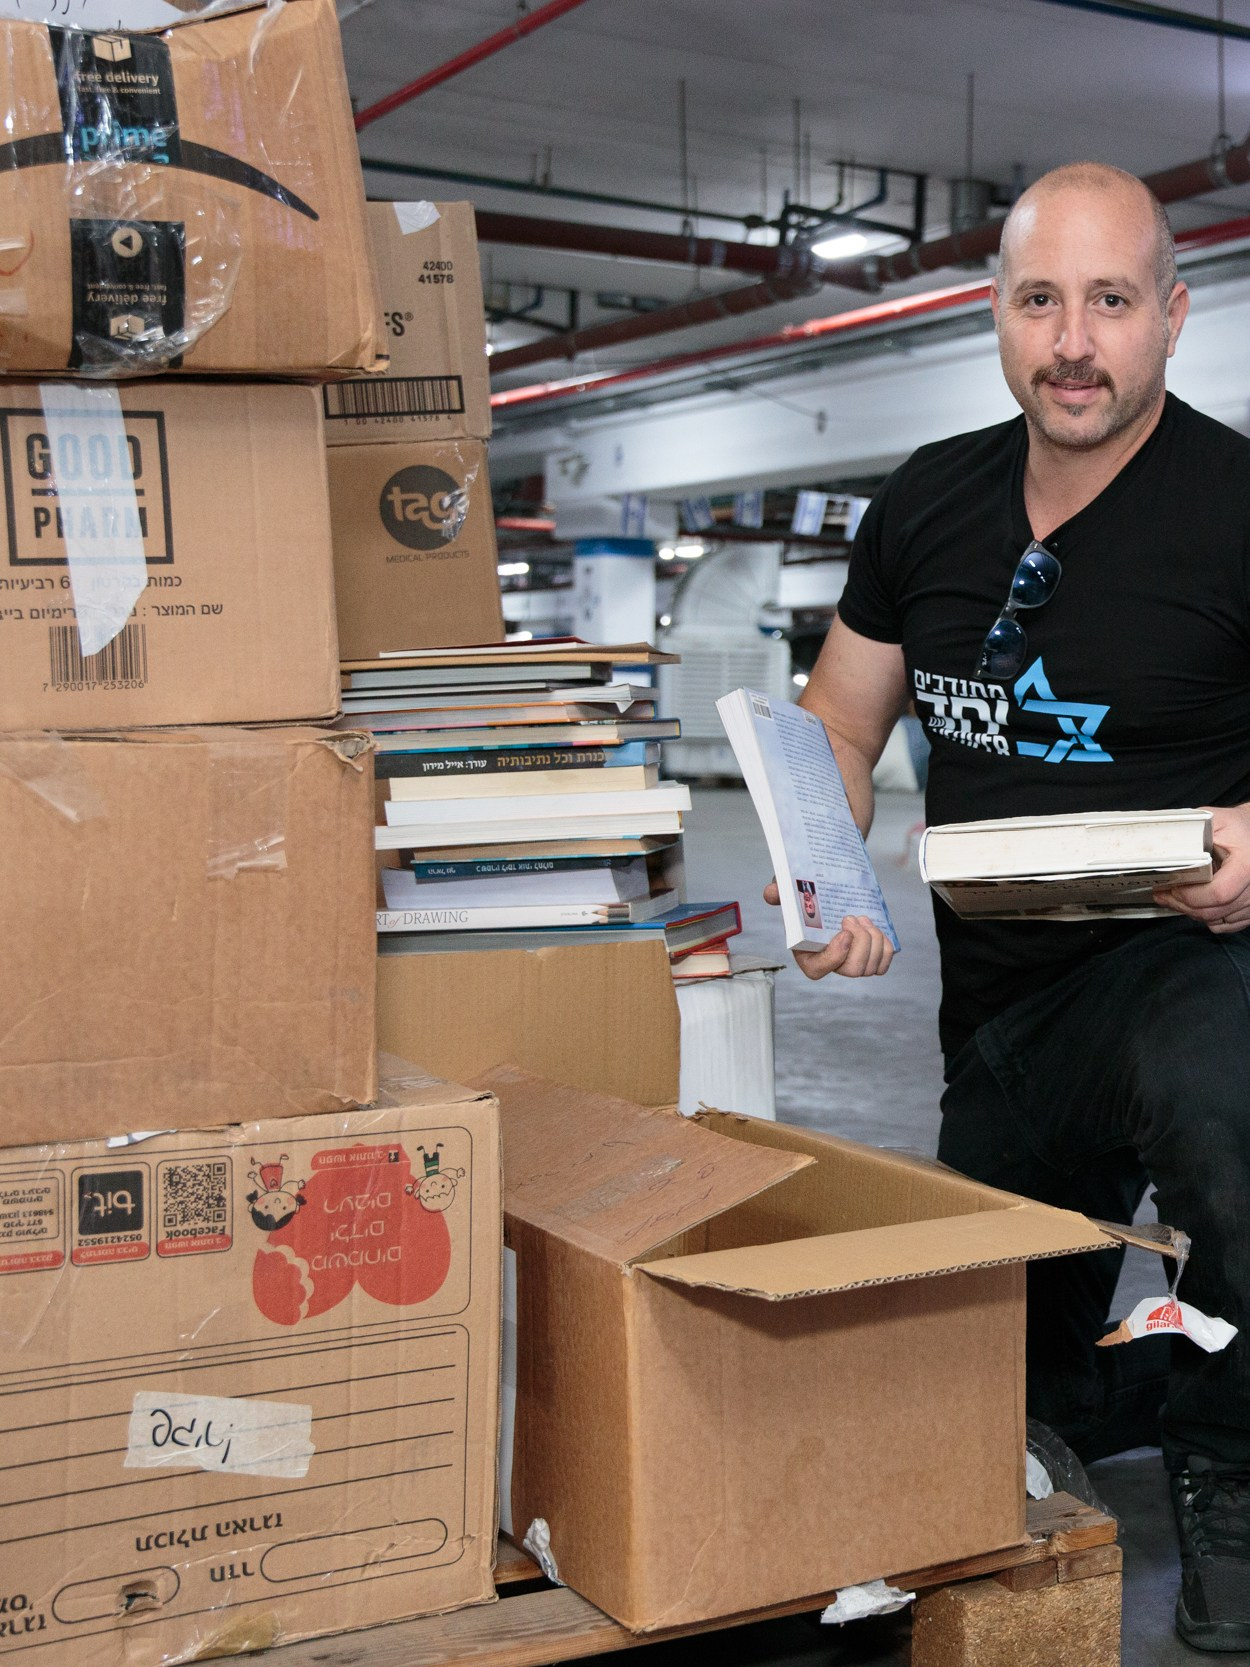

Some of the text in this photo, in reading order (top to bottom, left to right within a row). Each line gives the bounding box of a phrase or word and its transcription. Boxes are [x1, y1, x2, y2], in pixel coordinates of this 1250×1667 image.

[105, 71, 159, 86] delivery
[120, 87, 161, 95] convenient
[423, 261, 453, 271] 42400
[418, 274, 454, 284] 41578
[87, 292, 168, 305] free delivery
[26, 433, 143, 480] GOOD
[33, 507, 148, 538] PHARM
[386, 551, 470, 564] MEDICAL PRODUCTS
[60, 575, 71, 589] 6
[147, 576, 182, 588] כמות
[30, 607, 77, 619] רימיום
[151, 604, 195, 617] המוצר
[201, 604, 223, 616] שם
[43, 679, 144, 692] 7 290017 253206
[914, 668, 1008, 700] מתנדבים
[916, 689, 1009, 735] יחד
[465, 759, 488, 769] עורך:
[496, 753, 551, 767] נתיבותיה
[553, 752, 573, 764] וכל
[422, 761, 444, 772] מירון
[403, 910, 469, 926] DRAWING
[92, 1189, 135, 1218] bit
[323, 1192, 391, 1214] רעבים
[165, 1225, 227, 1240] Facebook
[330, 1220, 384, 1243] ילדים
[77, 1233, 143, 1247] 0524219552
[311, 1245, 402, 1271] משמחים
[135, 1512, 283, 1553] תכולת הארגז
[210, 1562, 255, 1583] חדר
